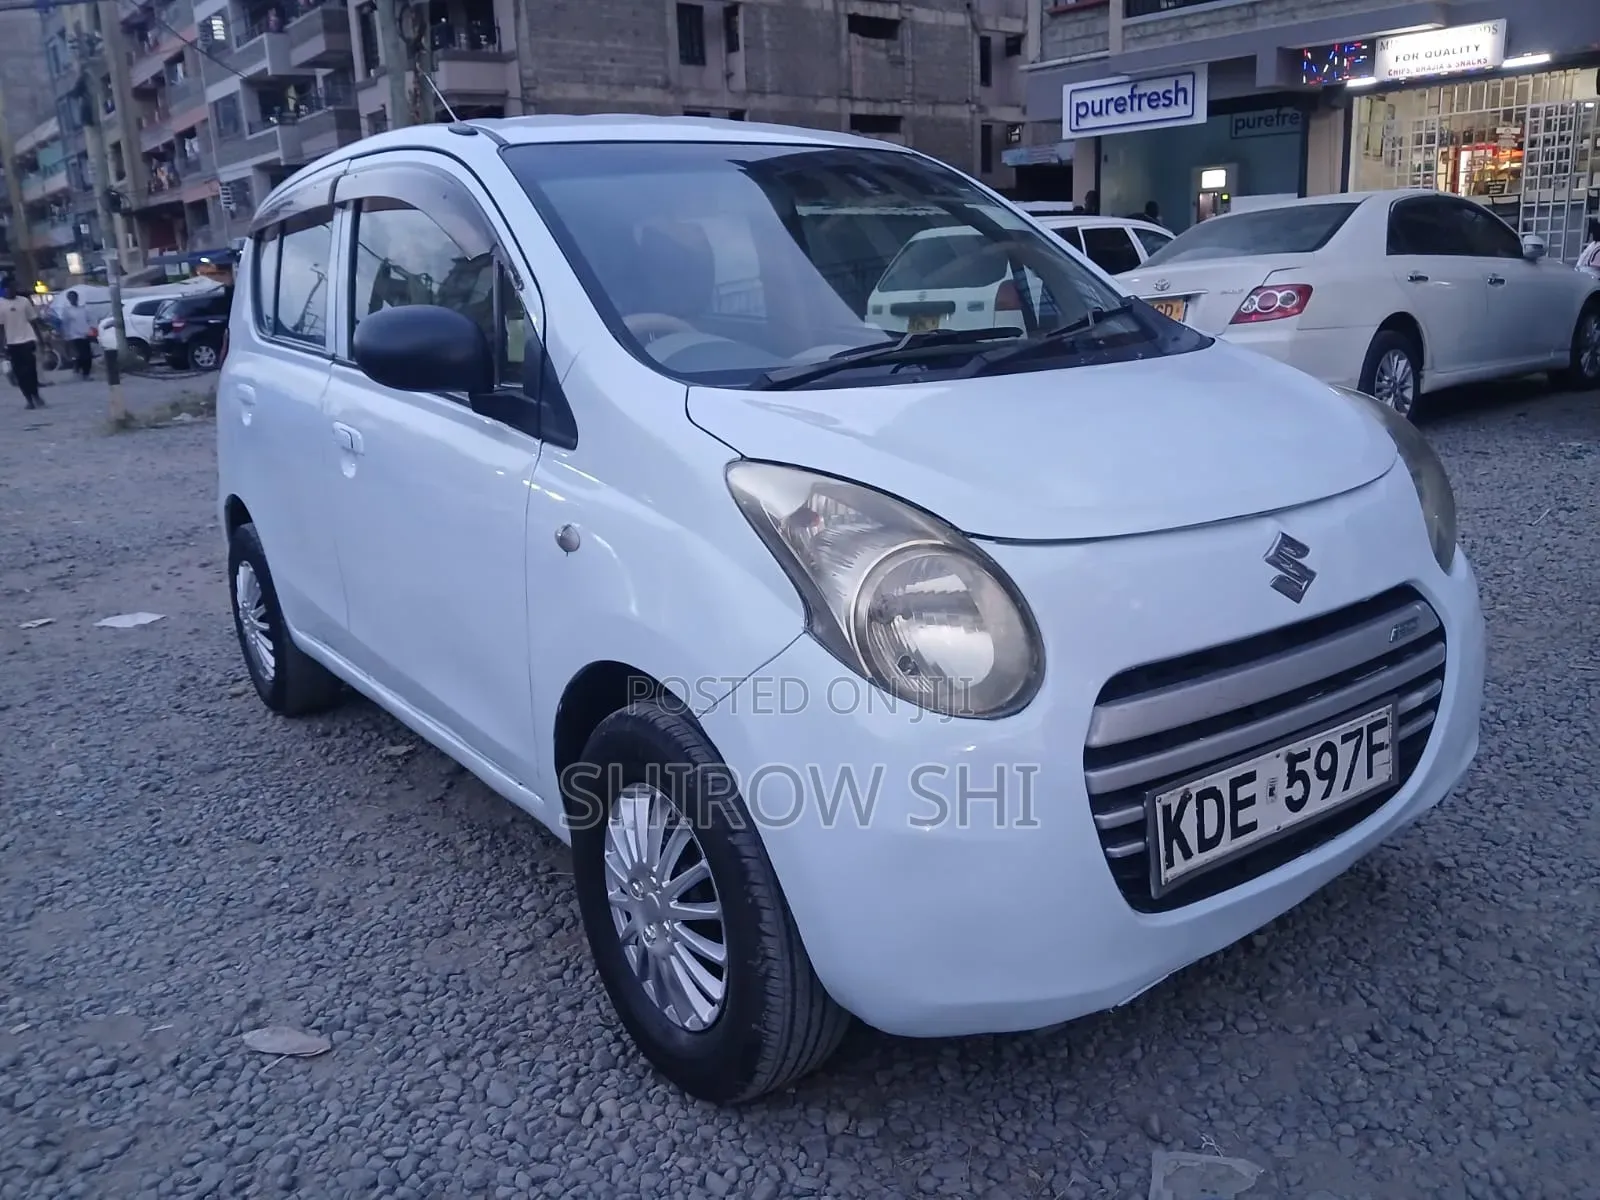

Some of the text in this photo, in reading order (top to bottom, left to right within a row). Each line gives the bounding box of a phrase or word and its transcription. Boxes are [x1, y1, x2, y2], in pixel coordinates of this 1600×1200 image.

[1394, 43, 1481, 63] FOR QUALITY
[1454, 57, 1488, 68] SNACKS
[1074, 80, 1189, 126] purefresh
[1234, 106, 1304, 136] purefre
[1161, 717, 1389, 869] KDE 597F
